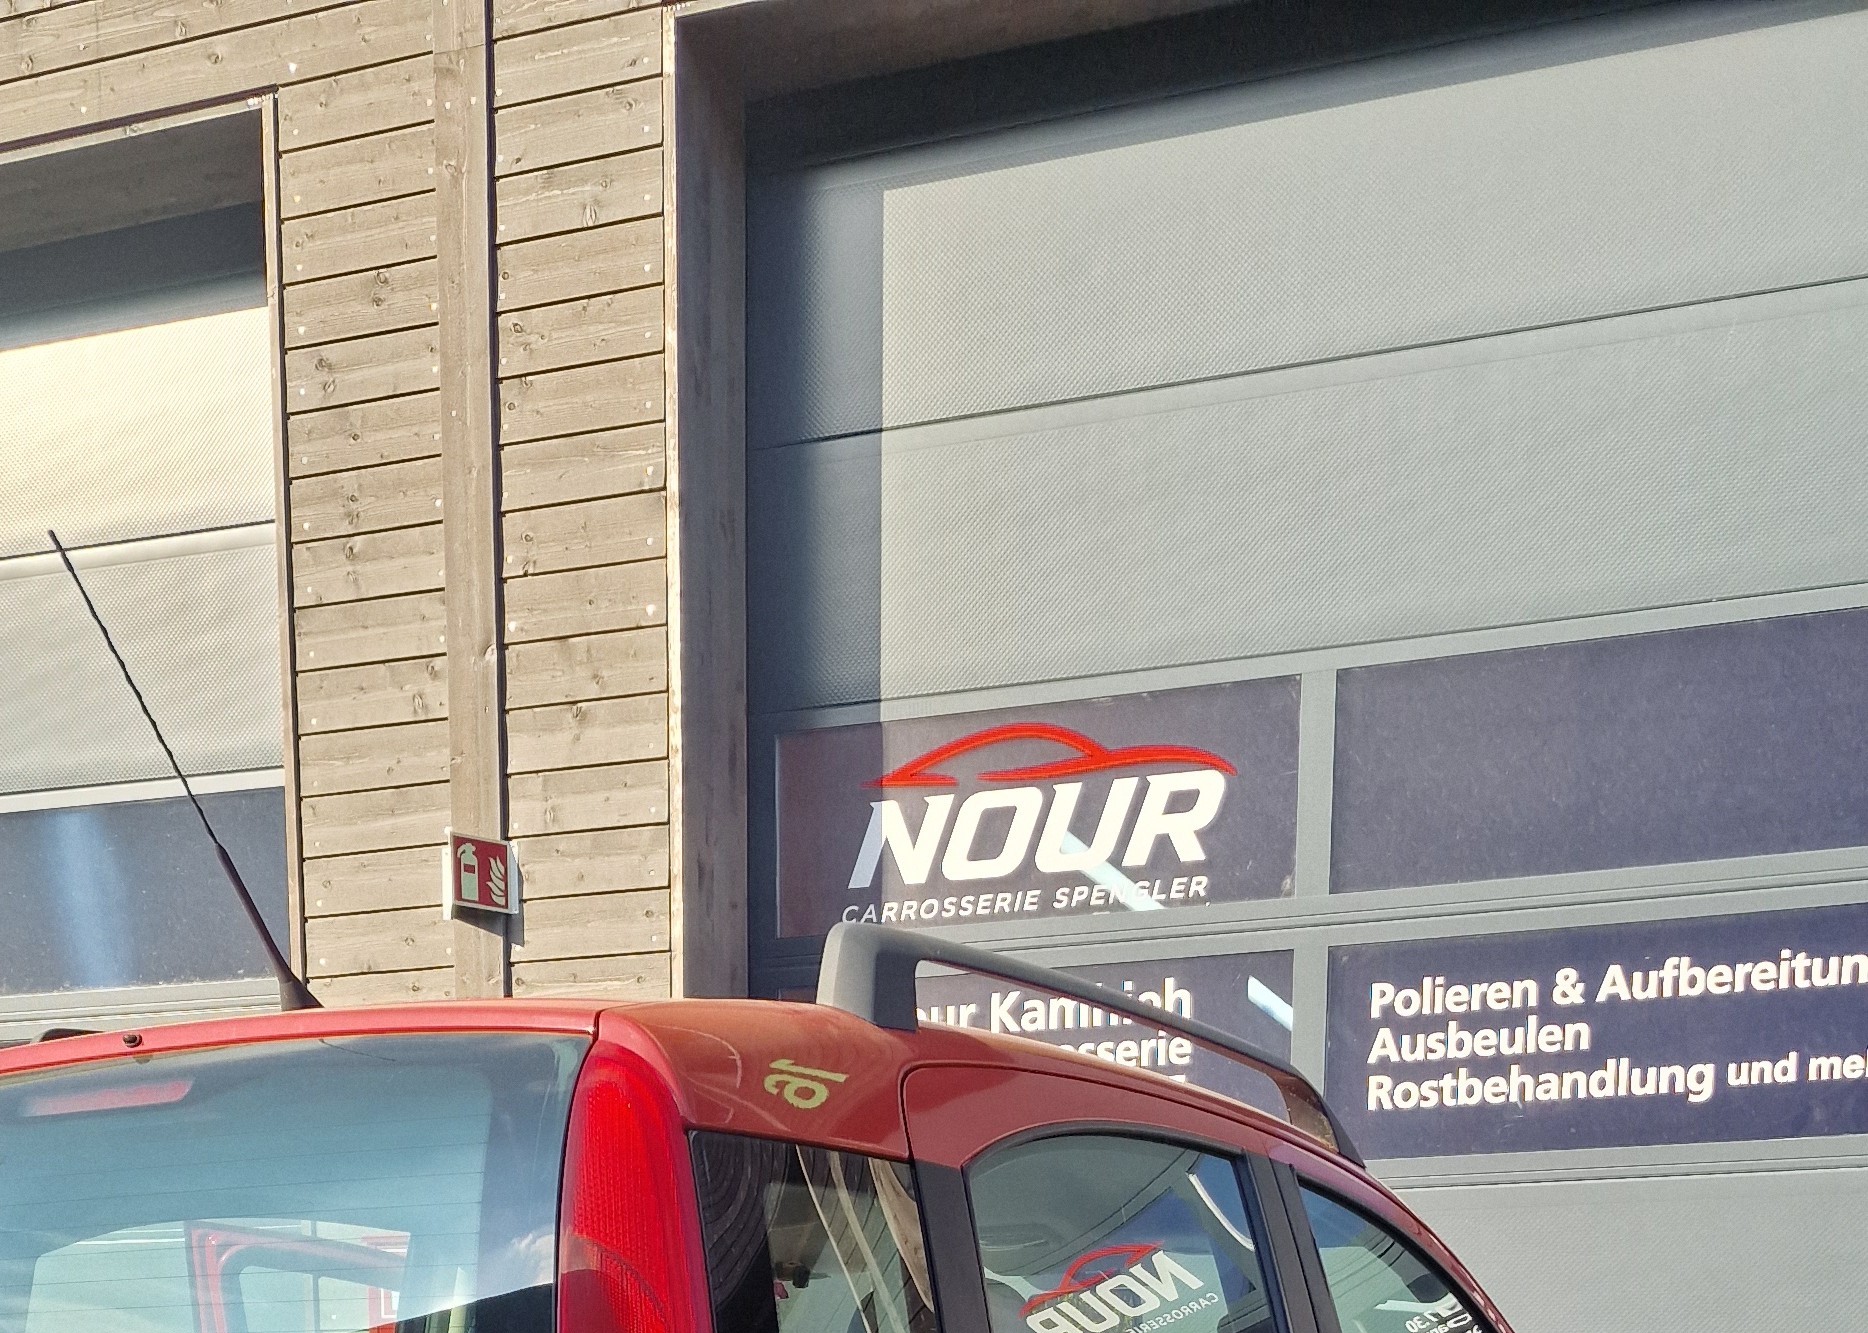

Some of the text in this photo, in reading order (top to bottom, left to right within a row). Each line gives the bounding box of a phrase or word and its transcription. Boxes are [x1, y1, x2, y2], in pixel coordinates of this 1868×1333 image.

[848, 769, 1226, 889] NOUR
[842, 875, 1208, 923] CARROSSERIE SPENGLER
[1369, 948, 1868, 1019] Polieren & Aufbereitun
[1366, 1015, 1591, 1064] Ausbeulen
[1366, 1048, 1868, 1111] Rostbehandlung und me
